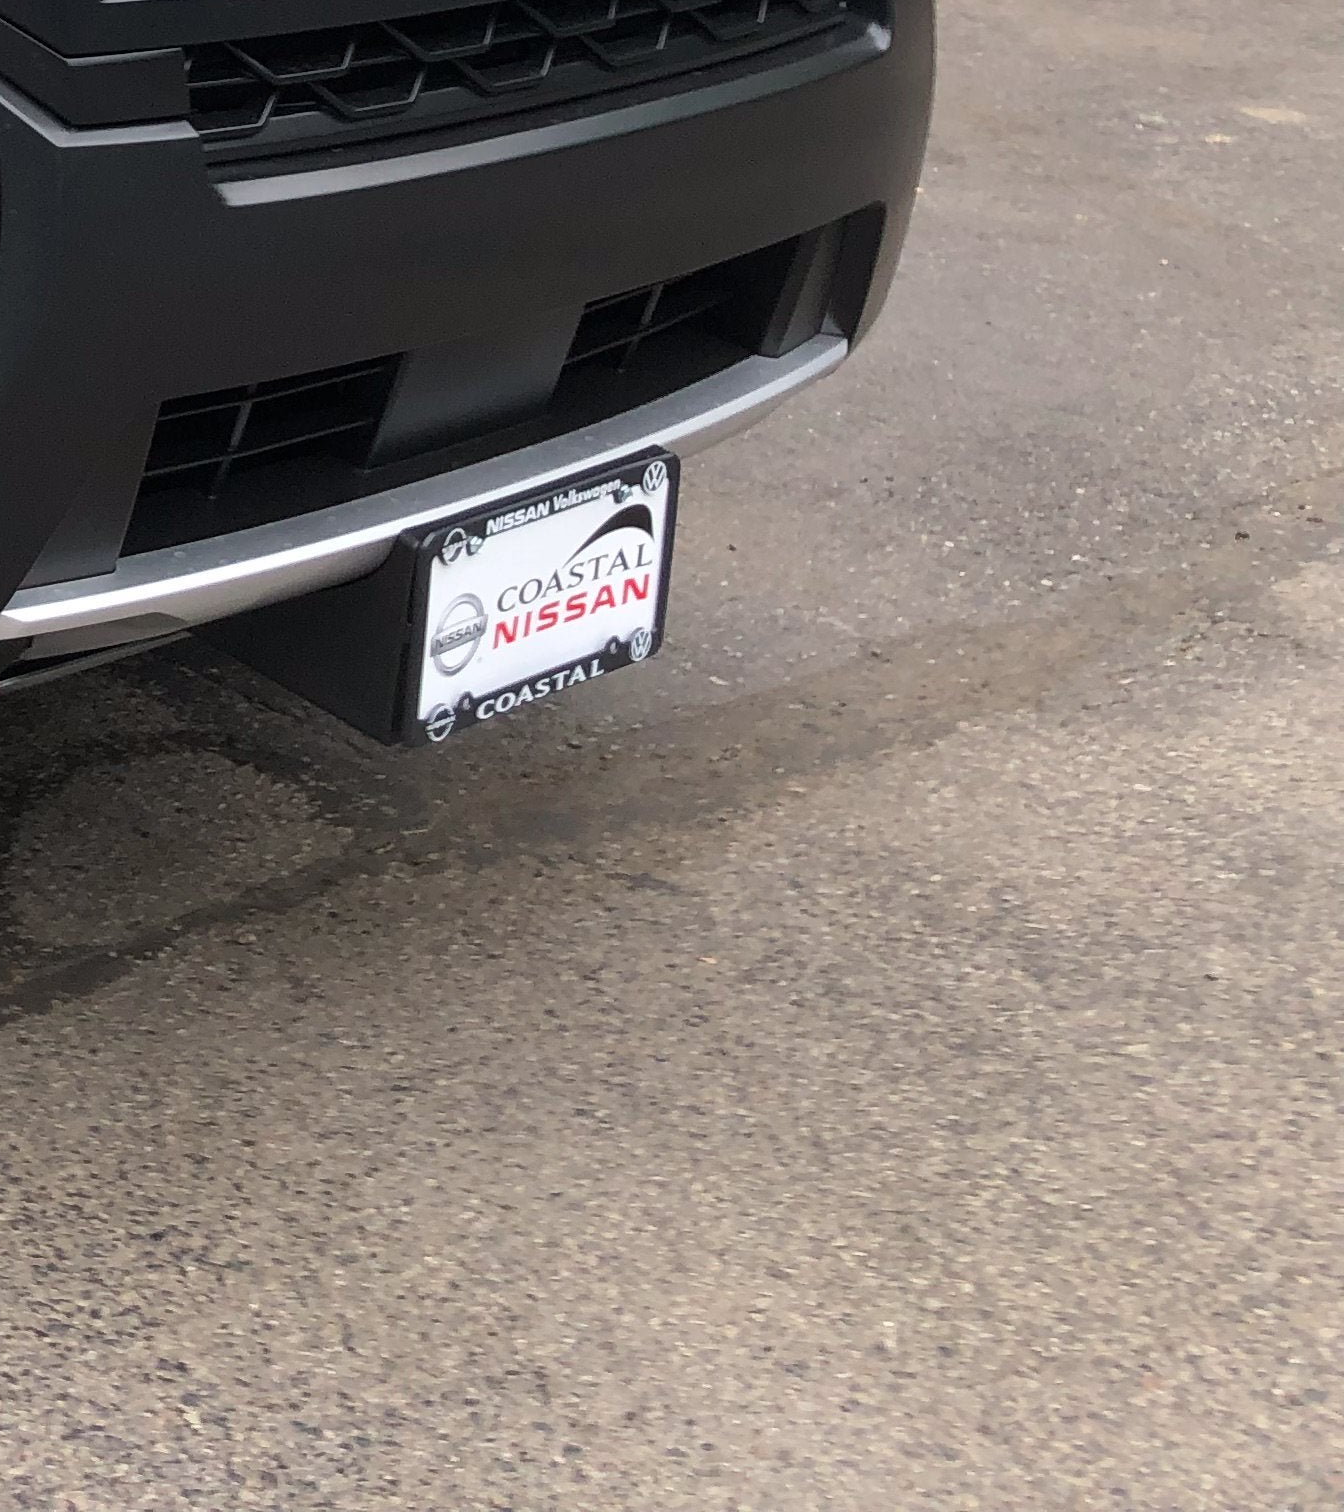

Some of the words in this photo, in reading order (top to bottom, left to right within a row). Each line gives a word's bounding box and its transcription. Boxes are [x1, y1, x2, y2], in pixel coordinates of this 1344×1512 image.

[486, 500, 550, 535] NISSAN
[496, 543, 653, 613] COASTAL
[435, 621, 483, 649] NISSAN
[492, 573, 650, 650] NISSAN
[474, 658, 606, 721] COASTAL
